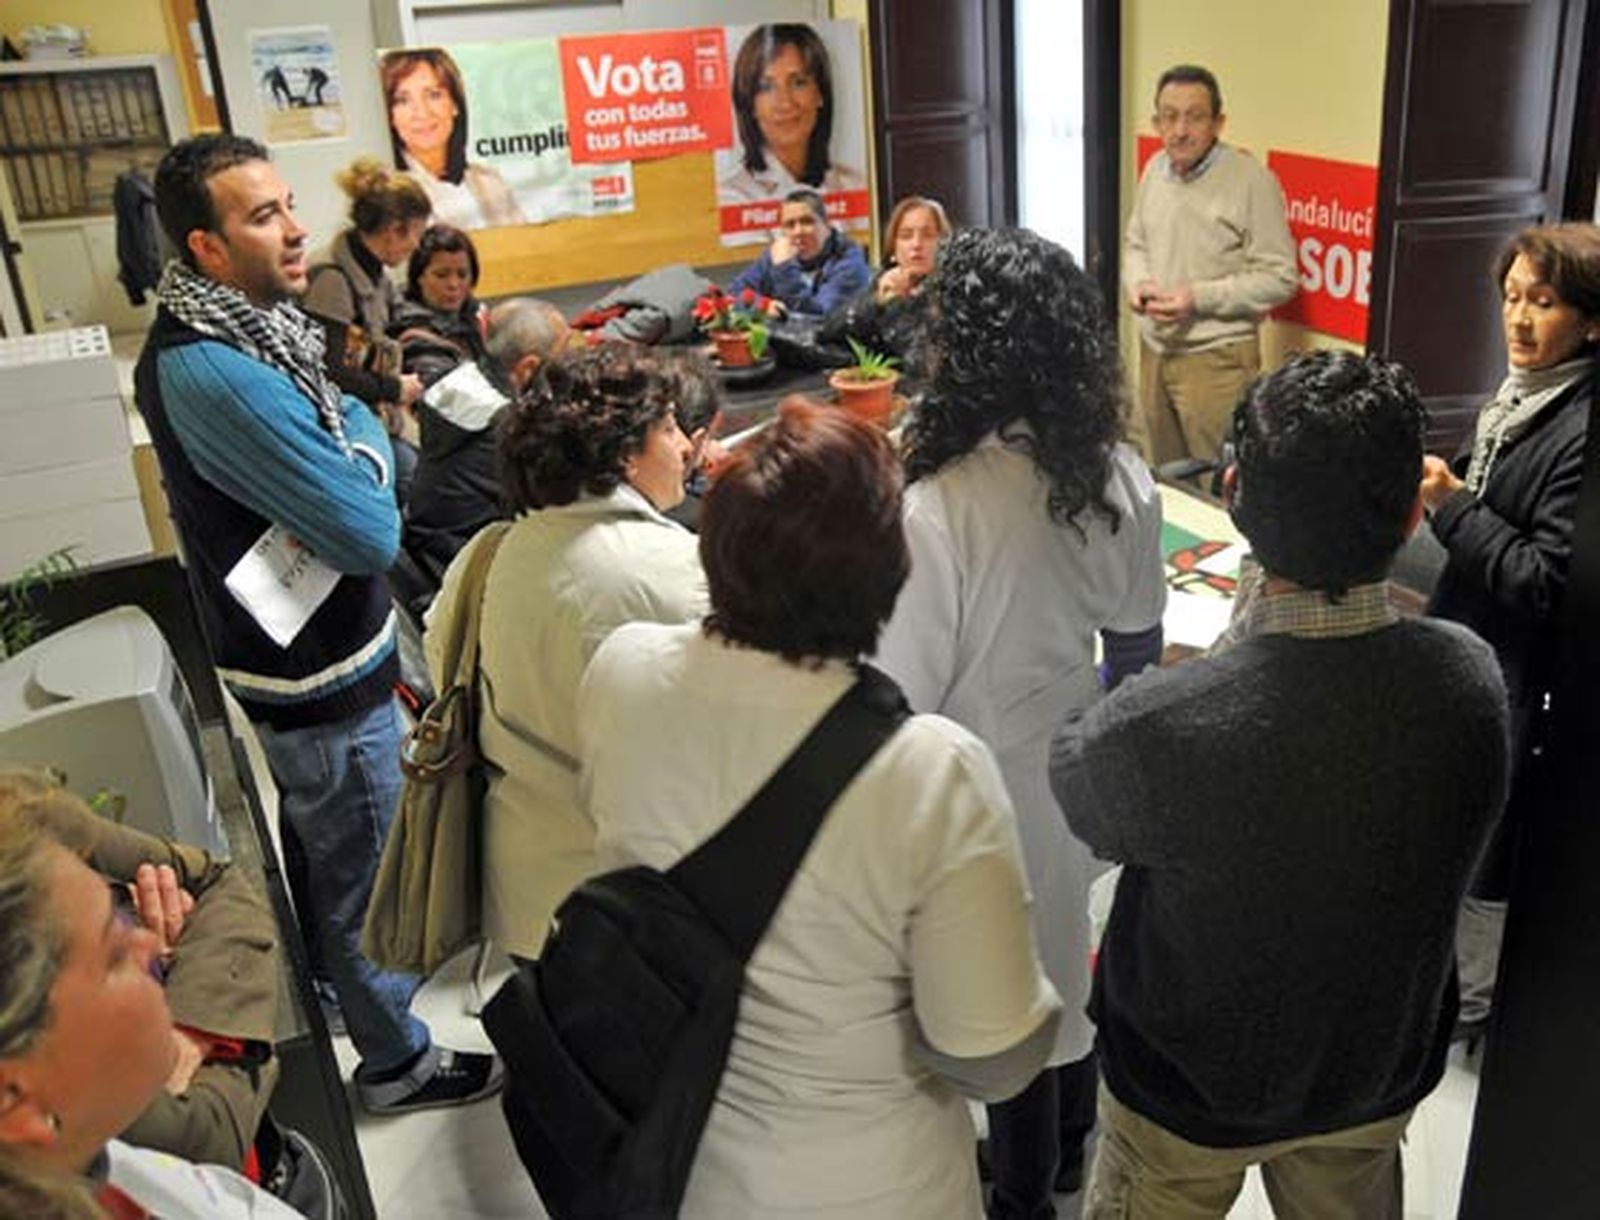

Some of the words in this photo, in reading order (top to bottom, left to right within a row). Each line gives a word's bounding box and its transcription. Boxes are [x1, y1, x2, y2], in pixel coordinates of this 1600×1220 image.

[576, 54, 685, 98] Vota
[584, 106, 625, 128] con
[628, 96, 688, 122] todas
[586, 131, 621, 152] tus
[624, 122, 708, 149] fuerzas.
[1299, 236, 1372, 305] SOE
